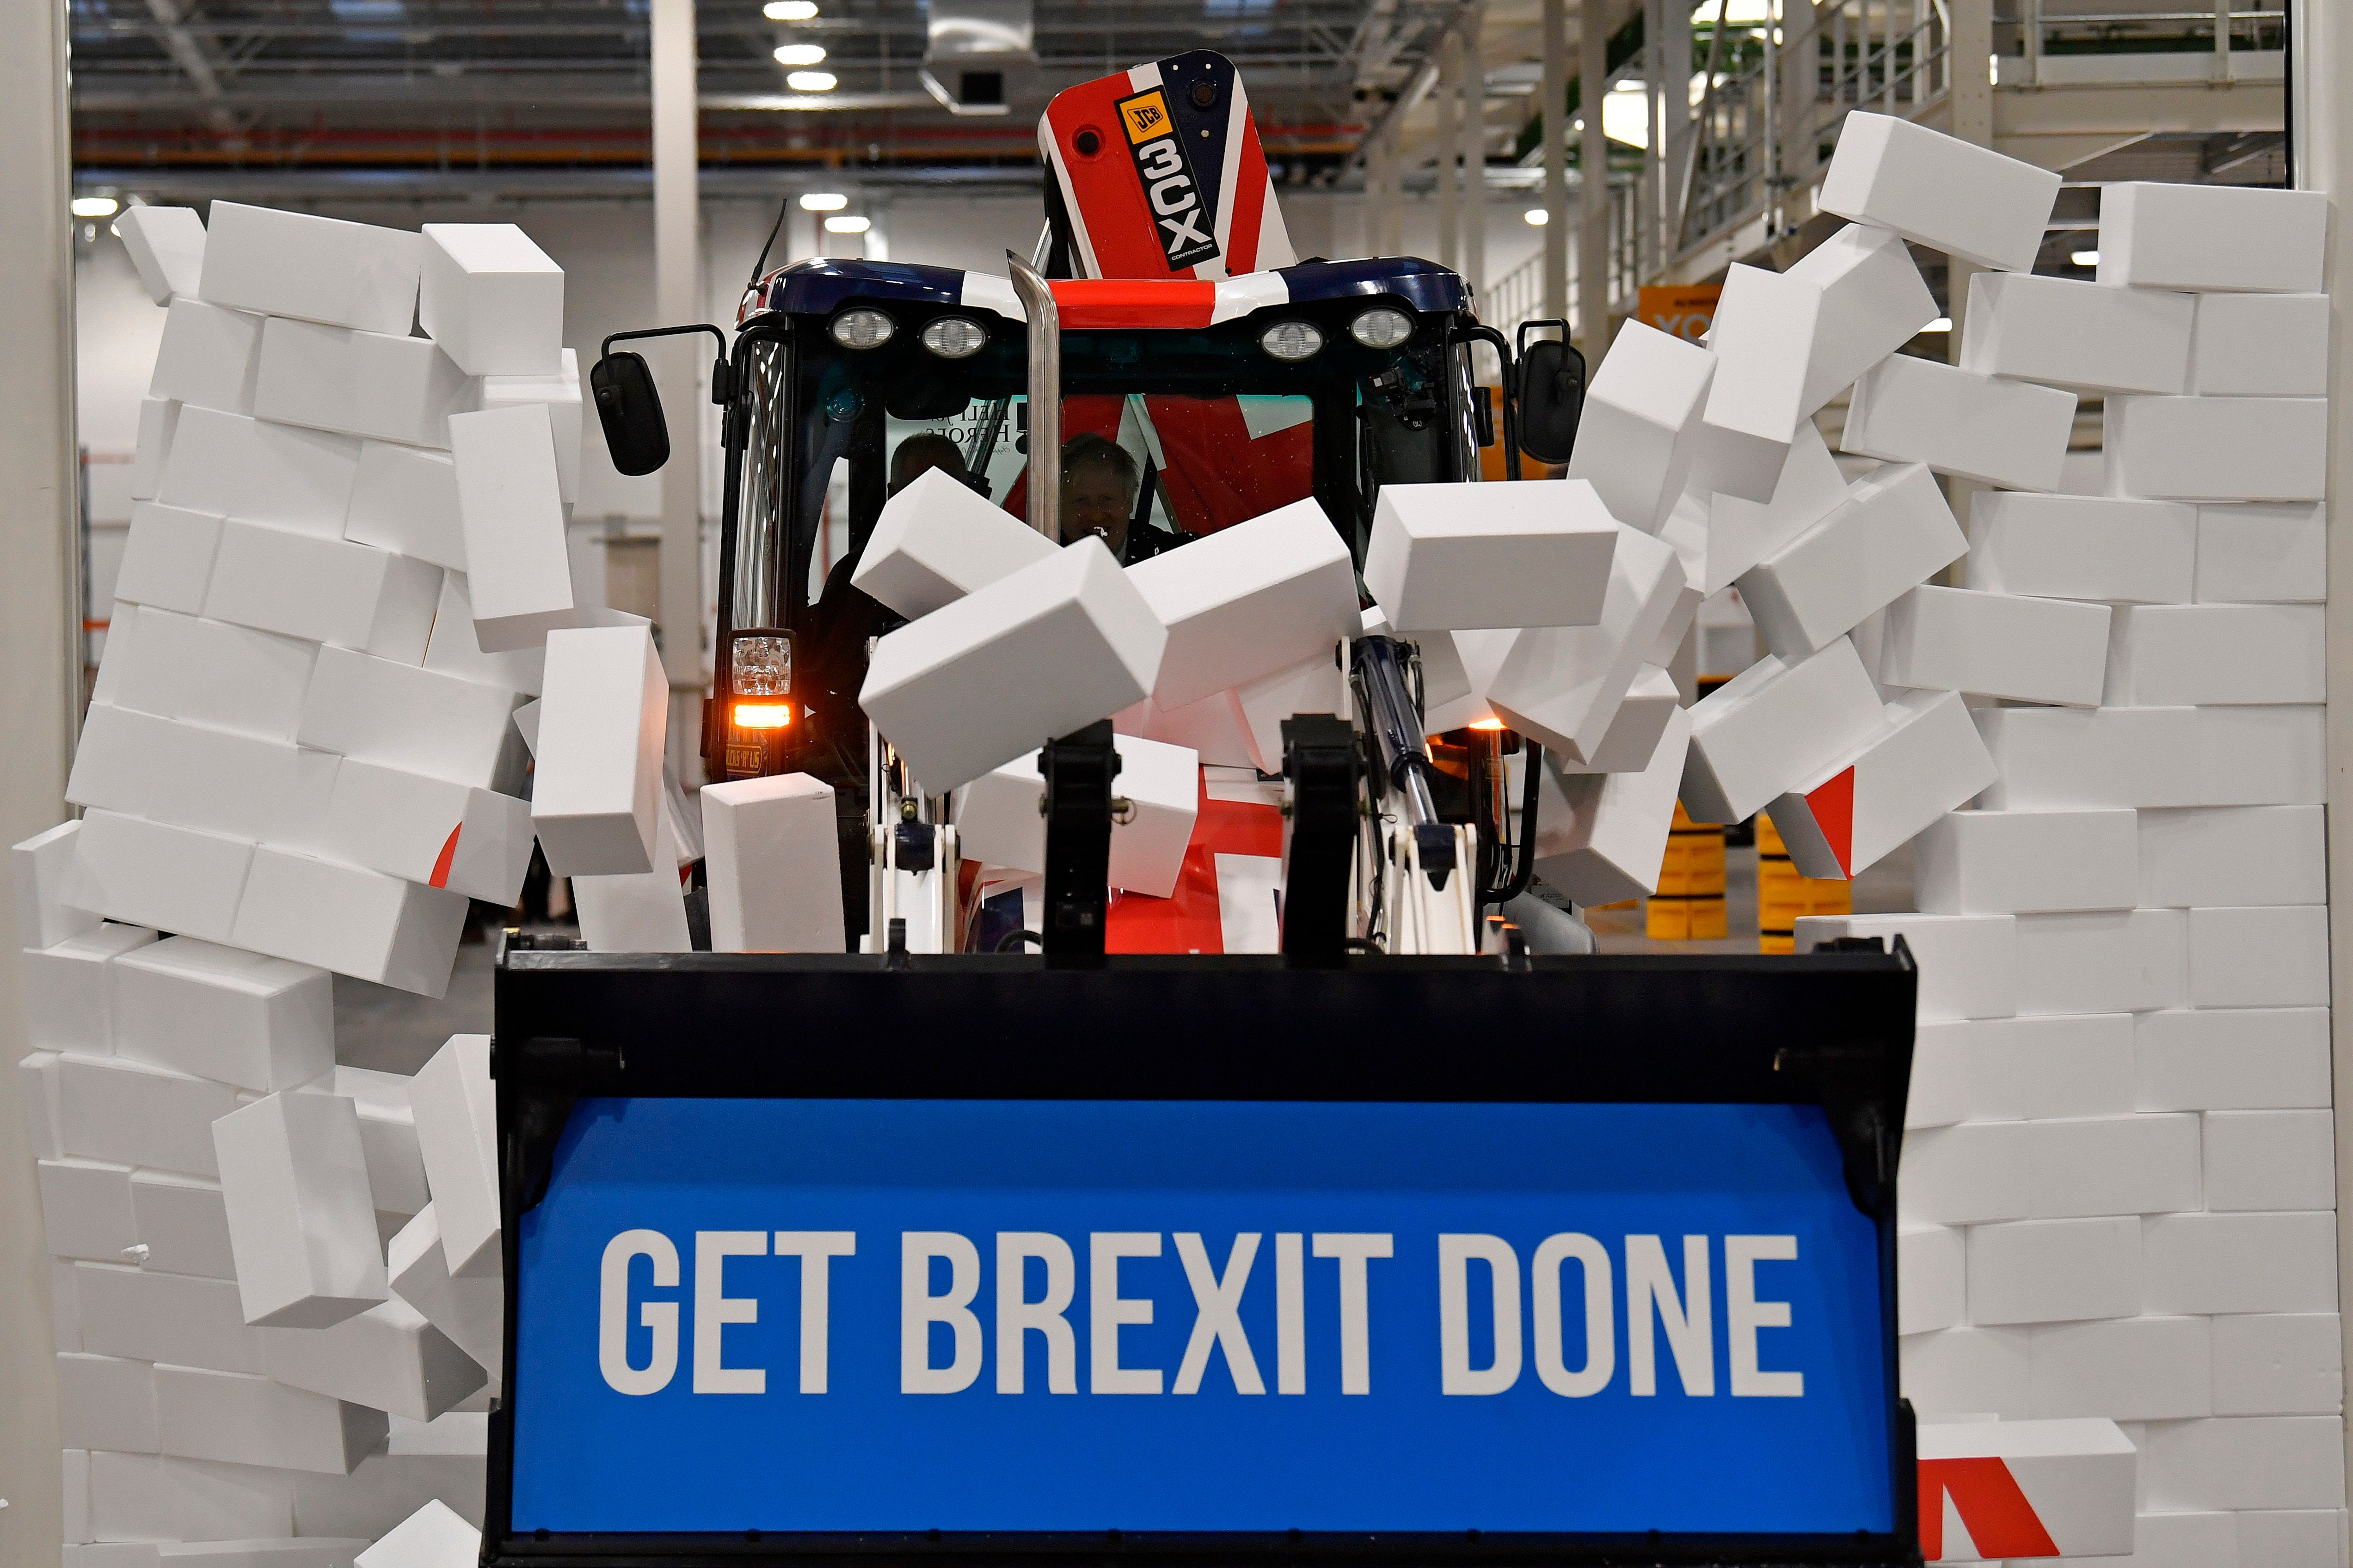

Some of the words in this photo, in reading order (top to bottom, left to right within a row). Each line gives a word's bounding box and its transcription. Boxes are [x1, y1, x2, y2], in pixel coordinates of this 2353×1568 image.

[1133, 107, 1161, 129] JCB
[1139, 139, 1212, 255] 3CX
[1171, 243, 1213, 261] CONTRACTOR
[599, 1229, 855, 1395] GET
[901, 1231, 1393, 1395] BREXIT
[1438, 1232, 1803, 1397] DONE
